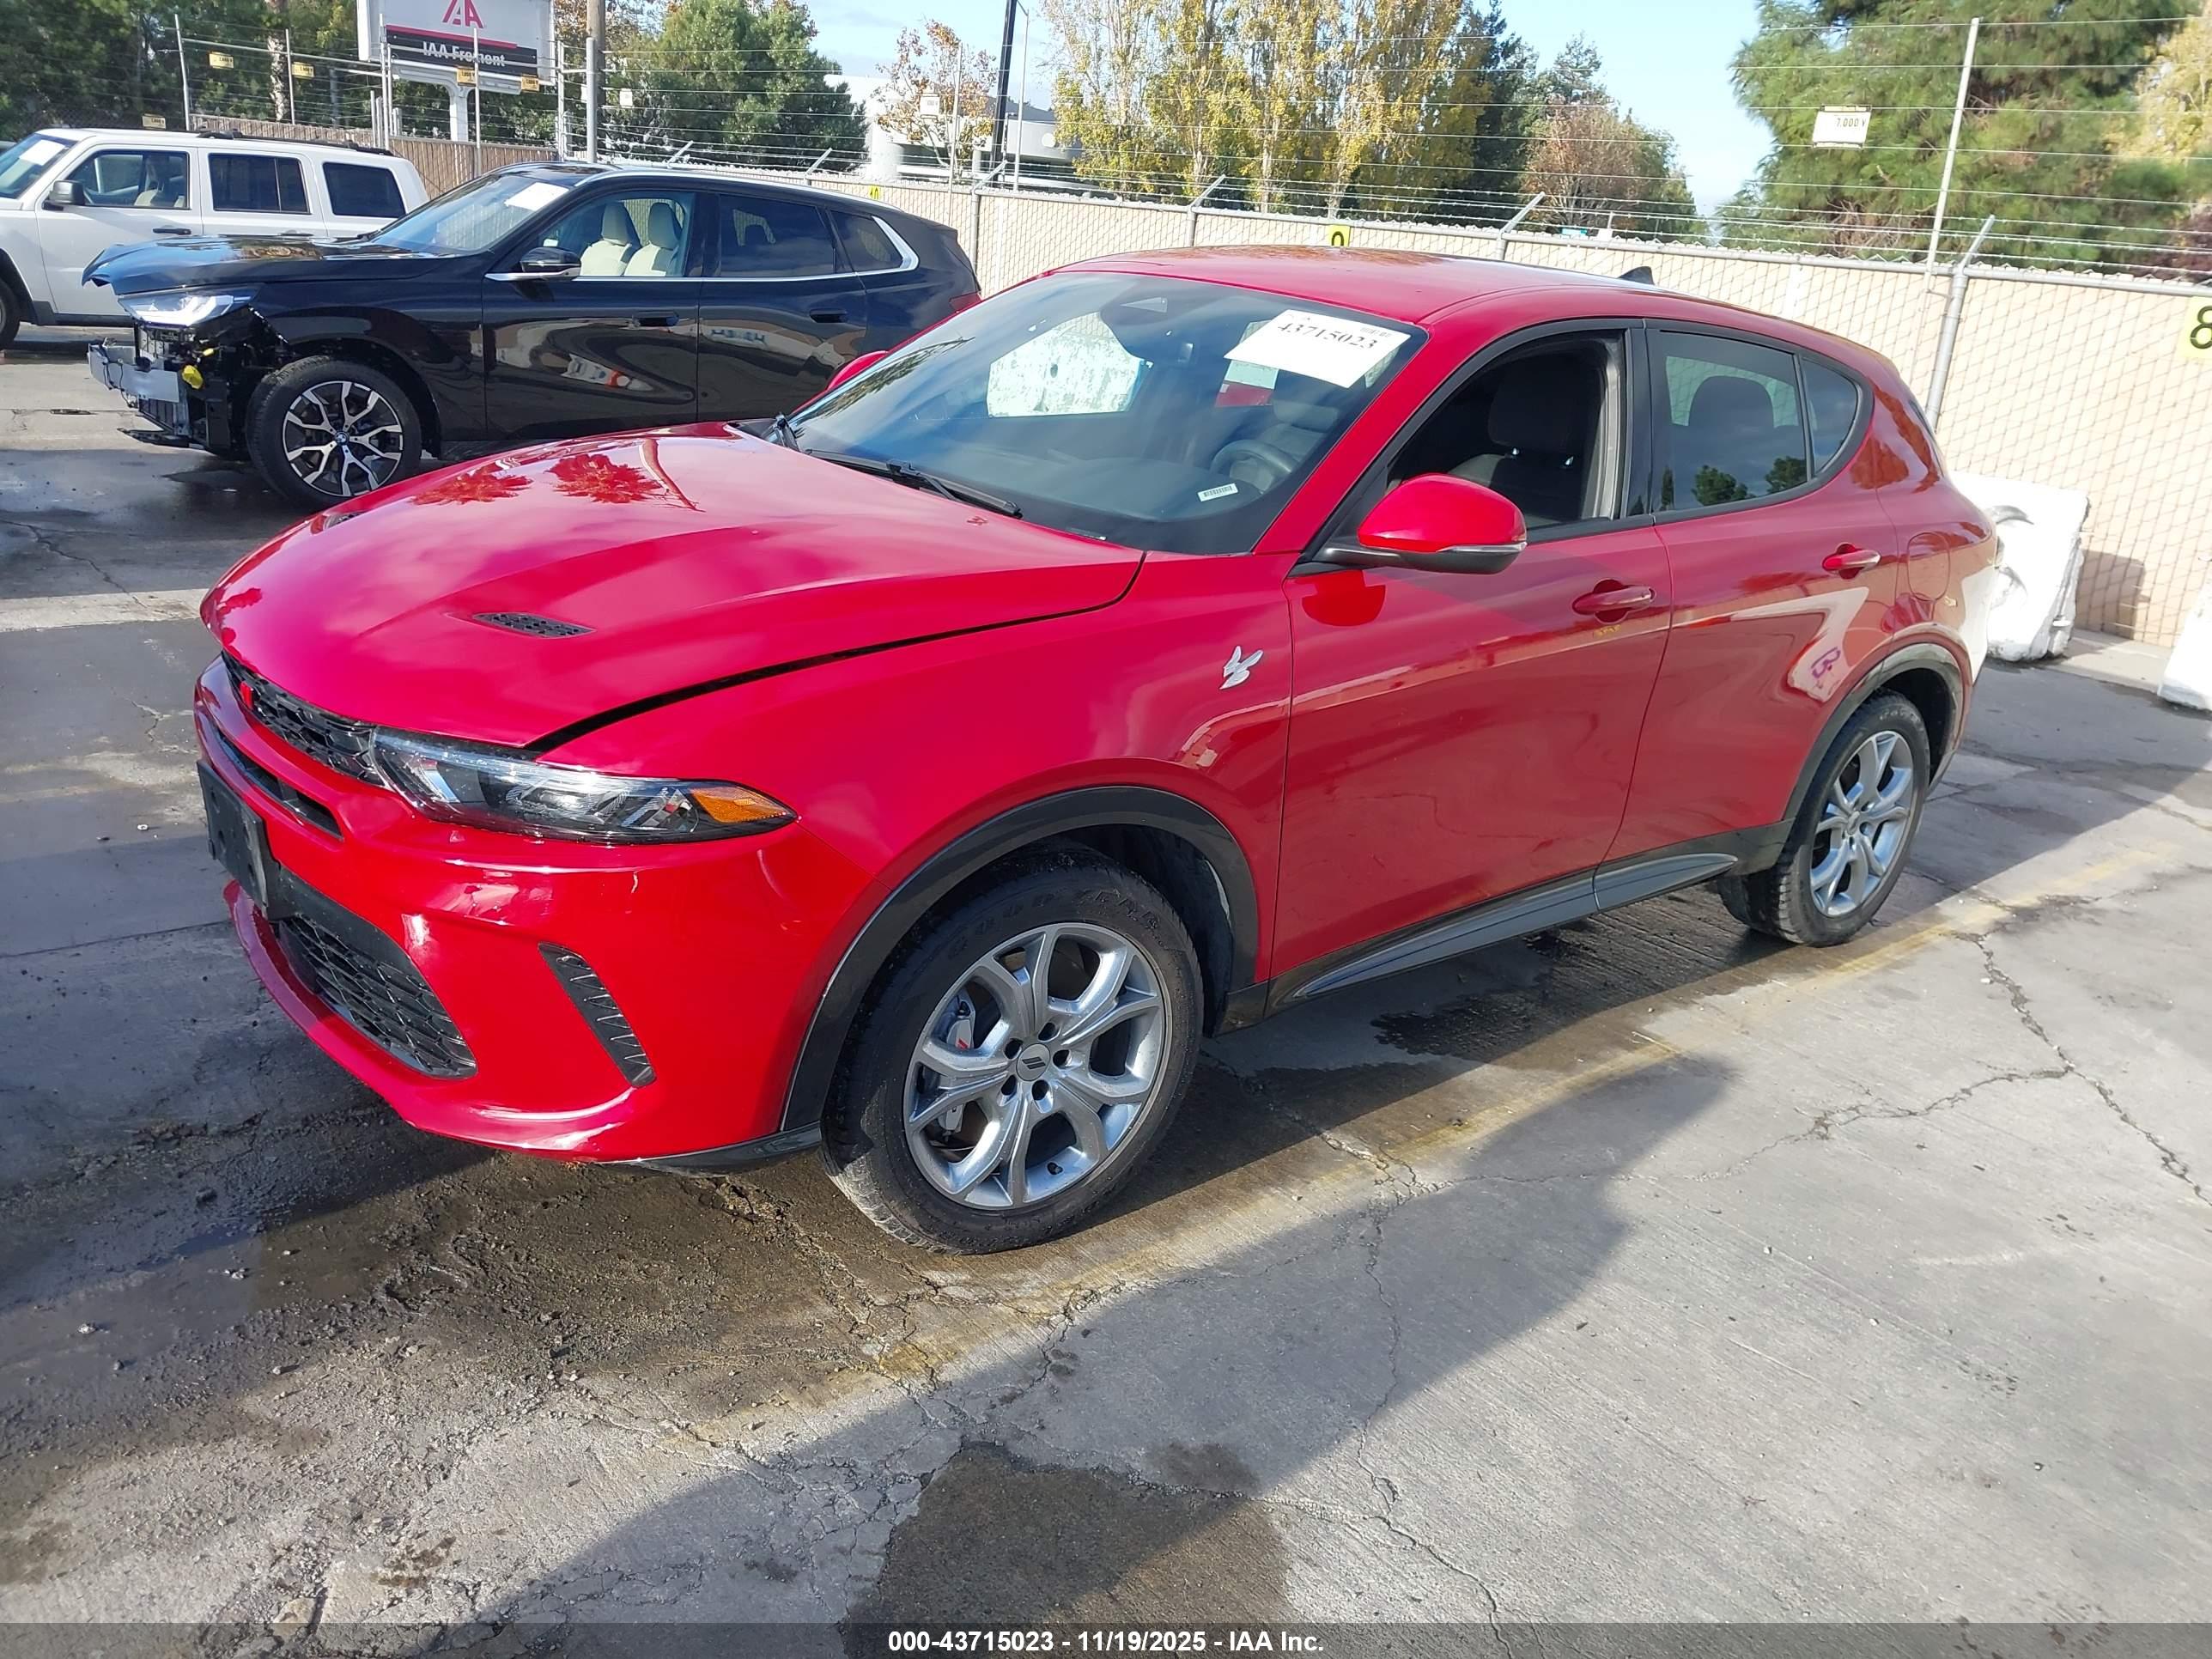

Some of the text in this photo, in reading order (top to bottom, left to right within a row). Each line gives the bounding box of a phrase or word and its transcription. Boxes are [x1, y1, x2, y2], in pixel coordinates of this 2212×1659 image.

[422, 41, 506, 67] IAA Fremont
[1277, 322, 1378, 349] 43715023
[2190, 306, 2212, 349] 8
